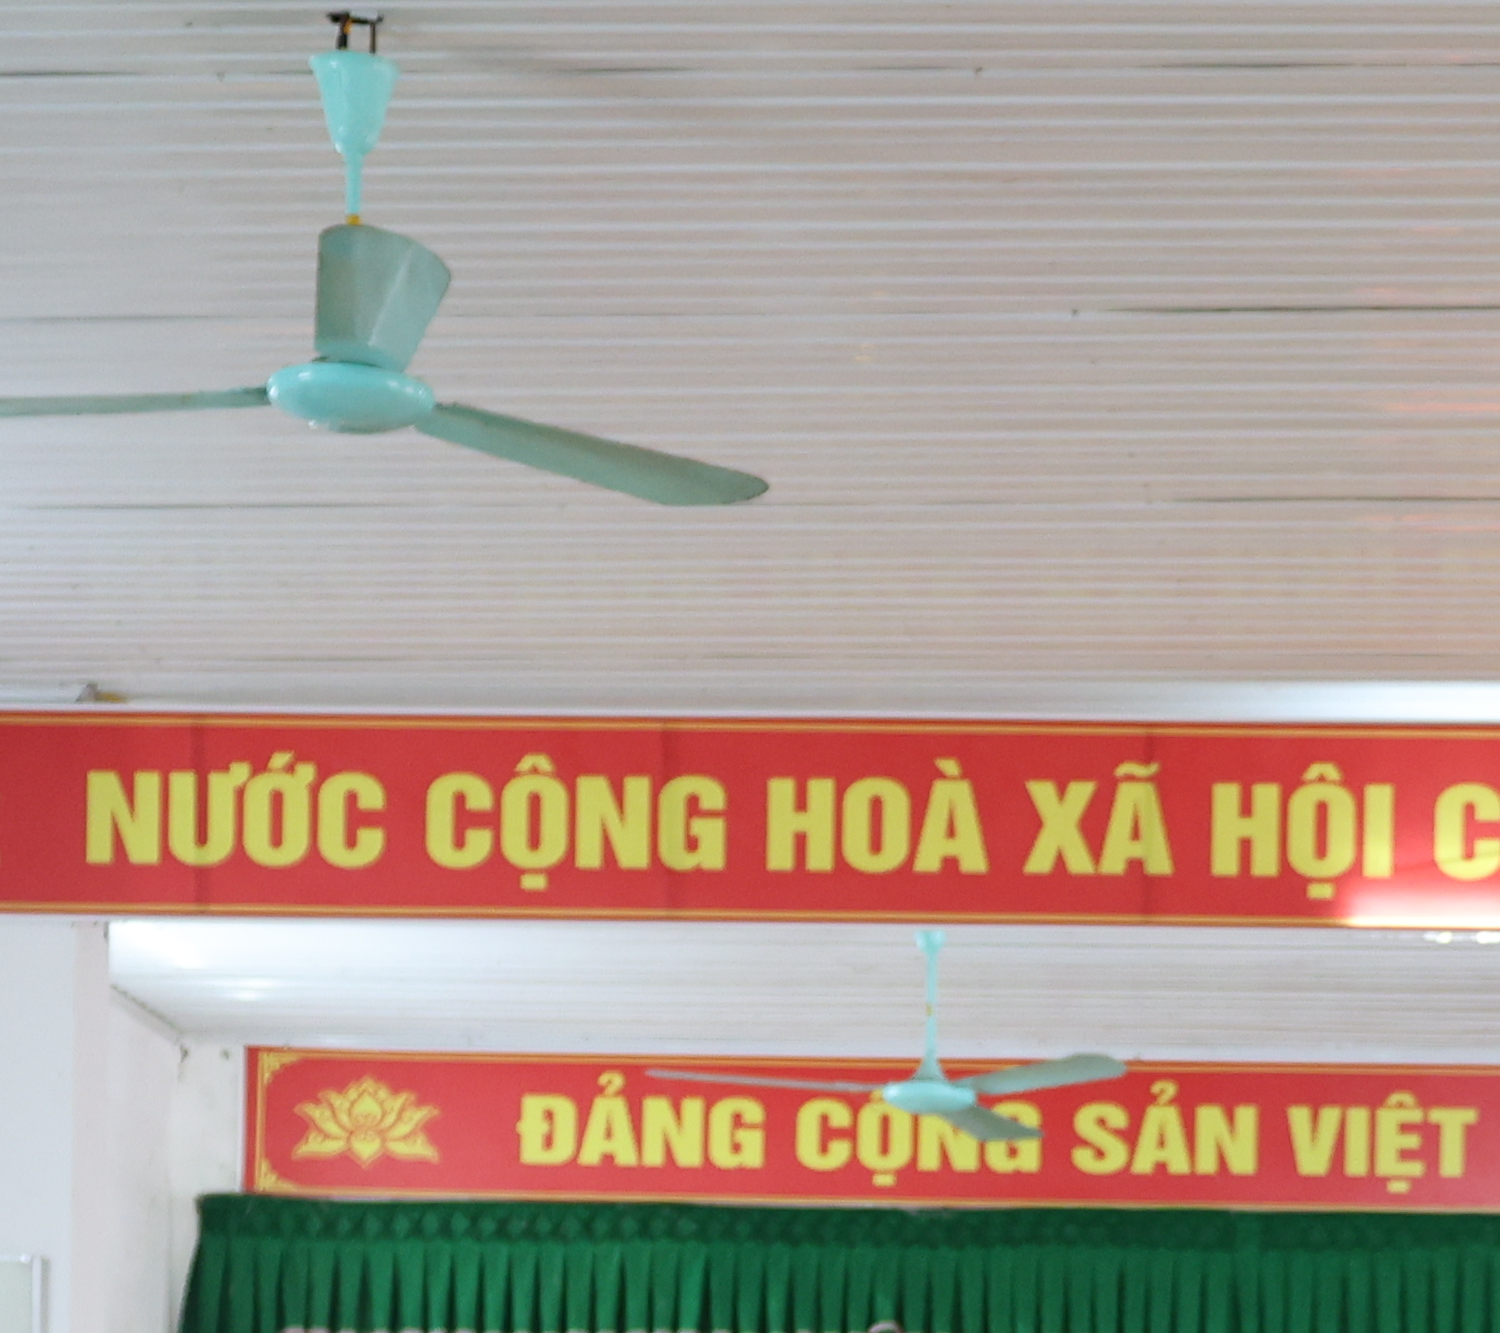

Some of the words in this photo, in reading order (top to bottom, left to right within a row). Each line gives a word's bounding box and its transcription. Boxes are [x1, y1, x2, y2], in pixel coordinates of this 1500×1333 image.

[86, 752, 386, 868] NƯỚC
[425, 754, 727, 891] CỘNG
[766, 758, 989, 873] HOÀ
[1024, 760, 1174, 875] XÃ
[1210, 760, 1394, 899] HỘI
[516, 1071, 766, 1169] ĐẢNG
[1071, 1080, 1259, 1175] SẢN
[1287, 1091, 1479, 1193] VIỆT
